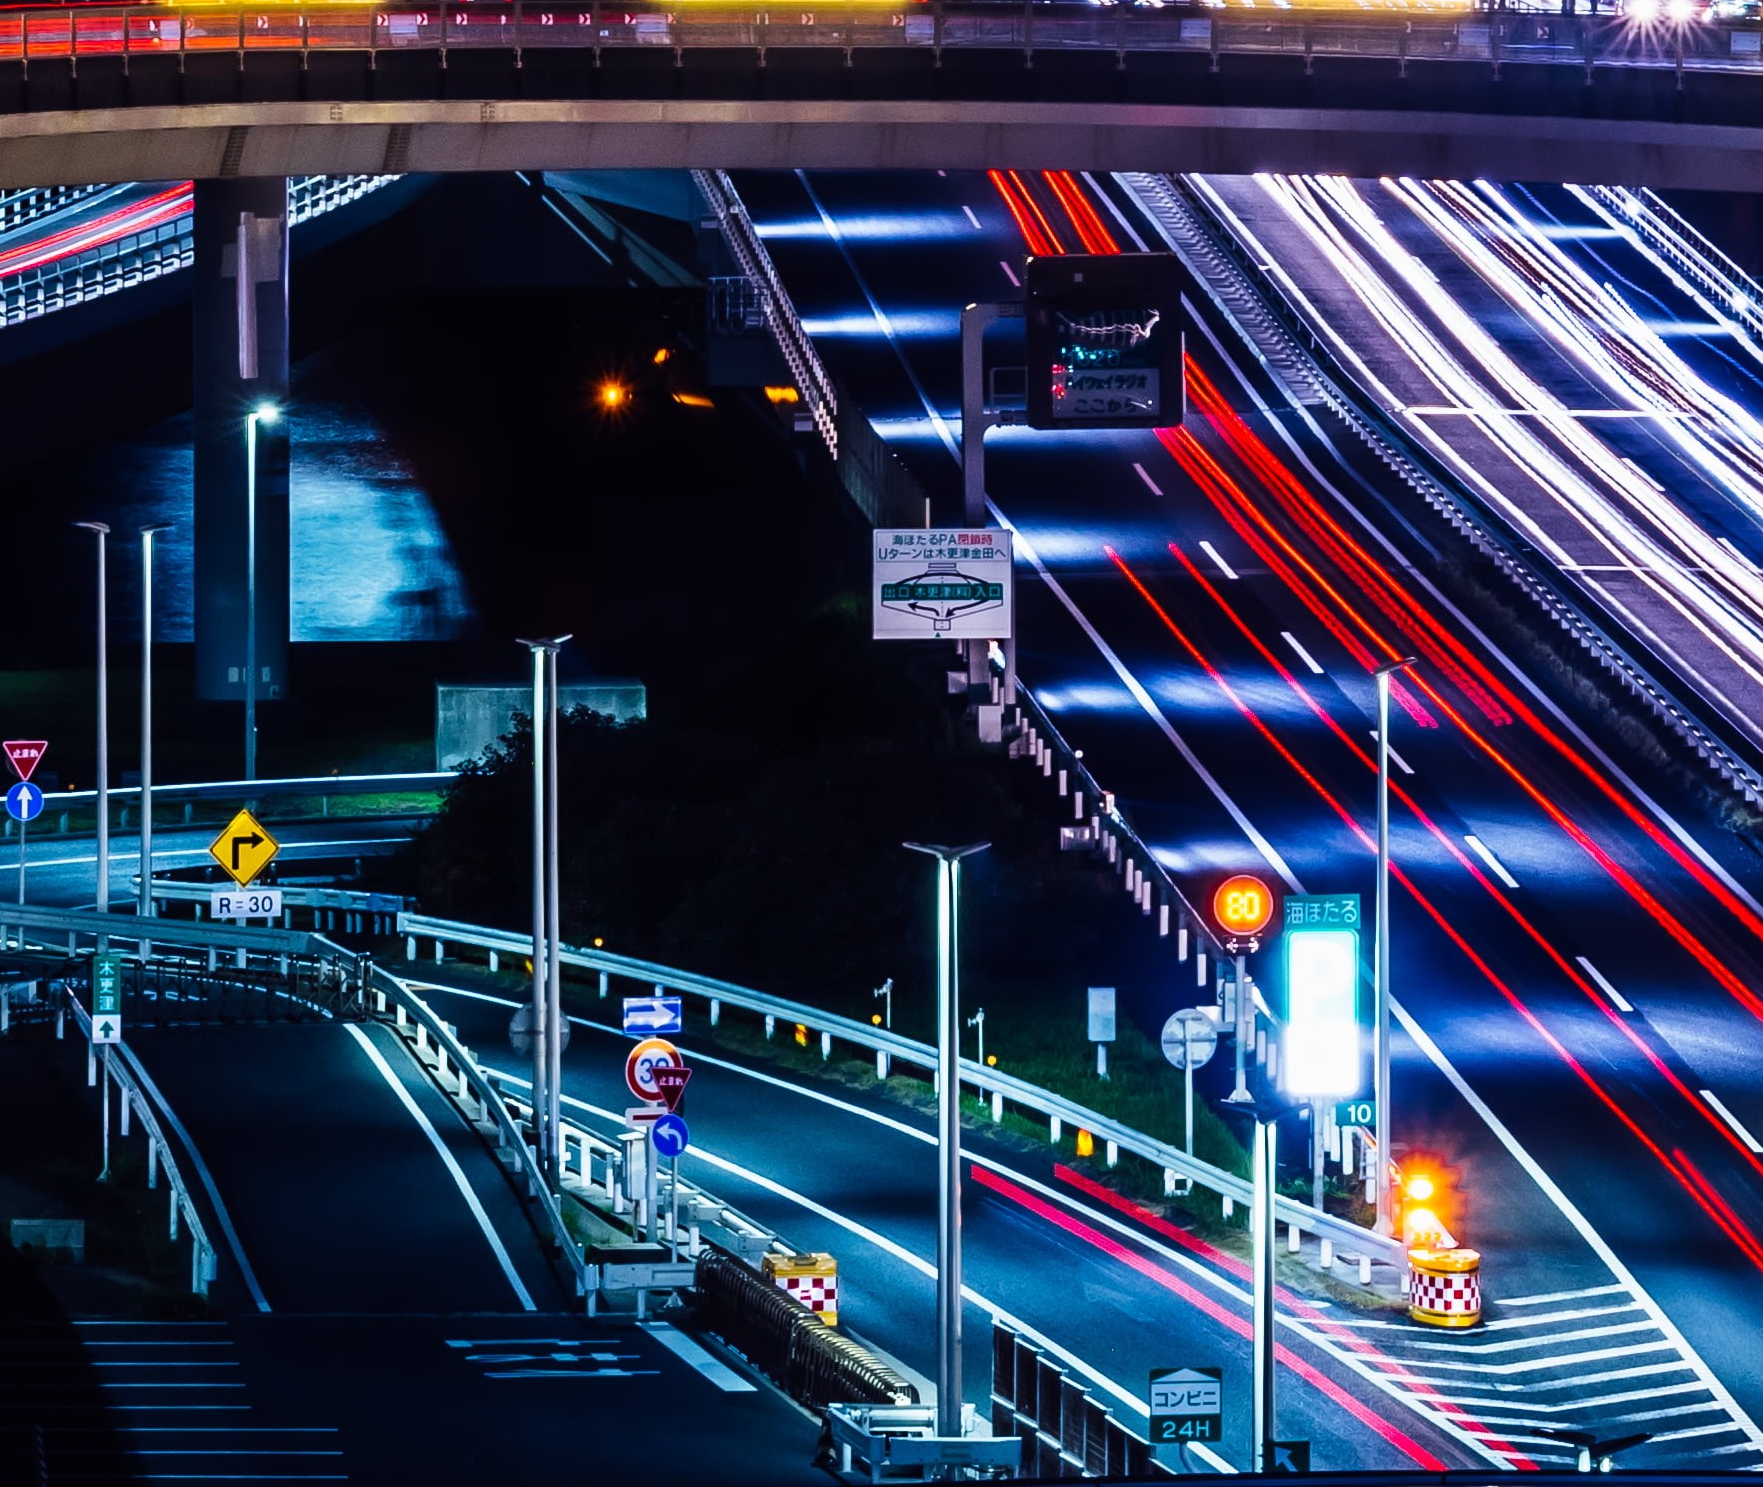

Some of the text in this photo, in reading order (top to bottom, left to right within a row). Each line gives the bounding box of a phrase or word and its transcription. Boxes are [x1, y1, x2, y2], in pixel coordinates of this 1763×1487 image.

[878, 547, 1006, 560] Uターンは木更津金田へ
[12, 748, 39, 758] 止まれ
[1226, 891, 1260, 920] 80
[1286, 900, 1358, 925] 海ほたる
[99, 960, 115, 1011] 木更津
[659, 1075, 684, 1086] 止まれ
[1347, 1103, 1372, 1124] 10
[1155, 1390, 1217, 1408] コンビニ
[1162, 1419, 1210, 1439] 24H
